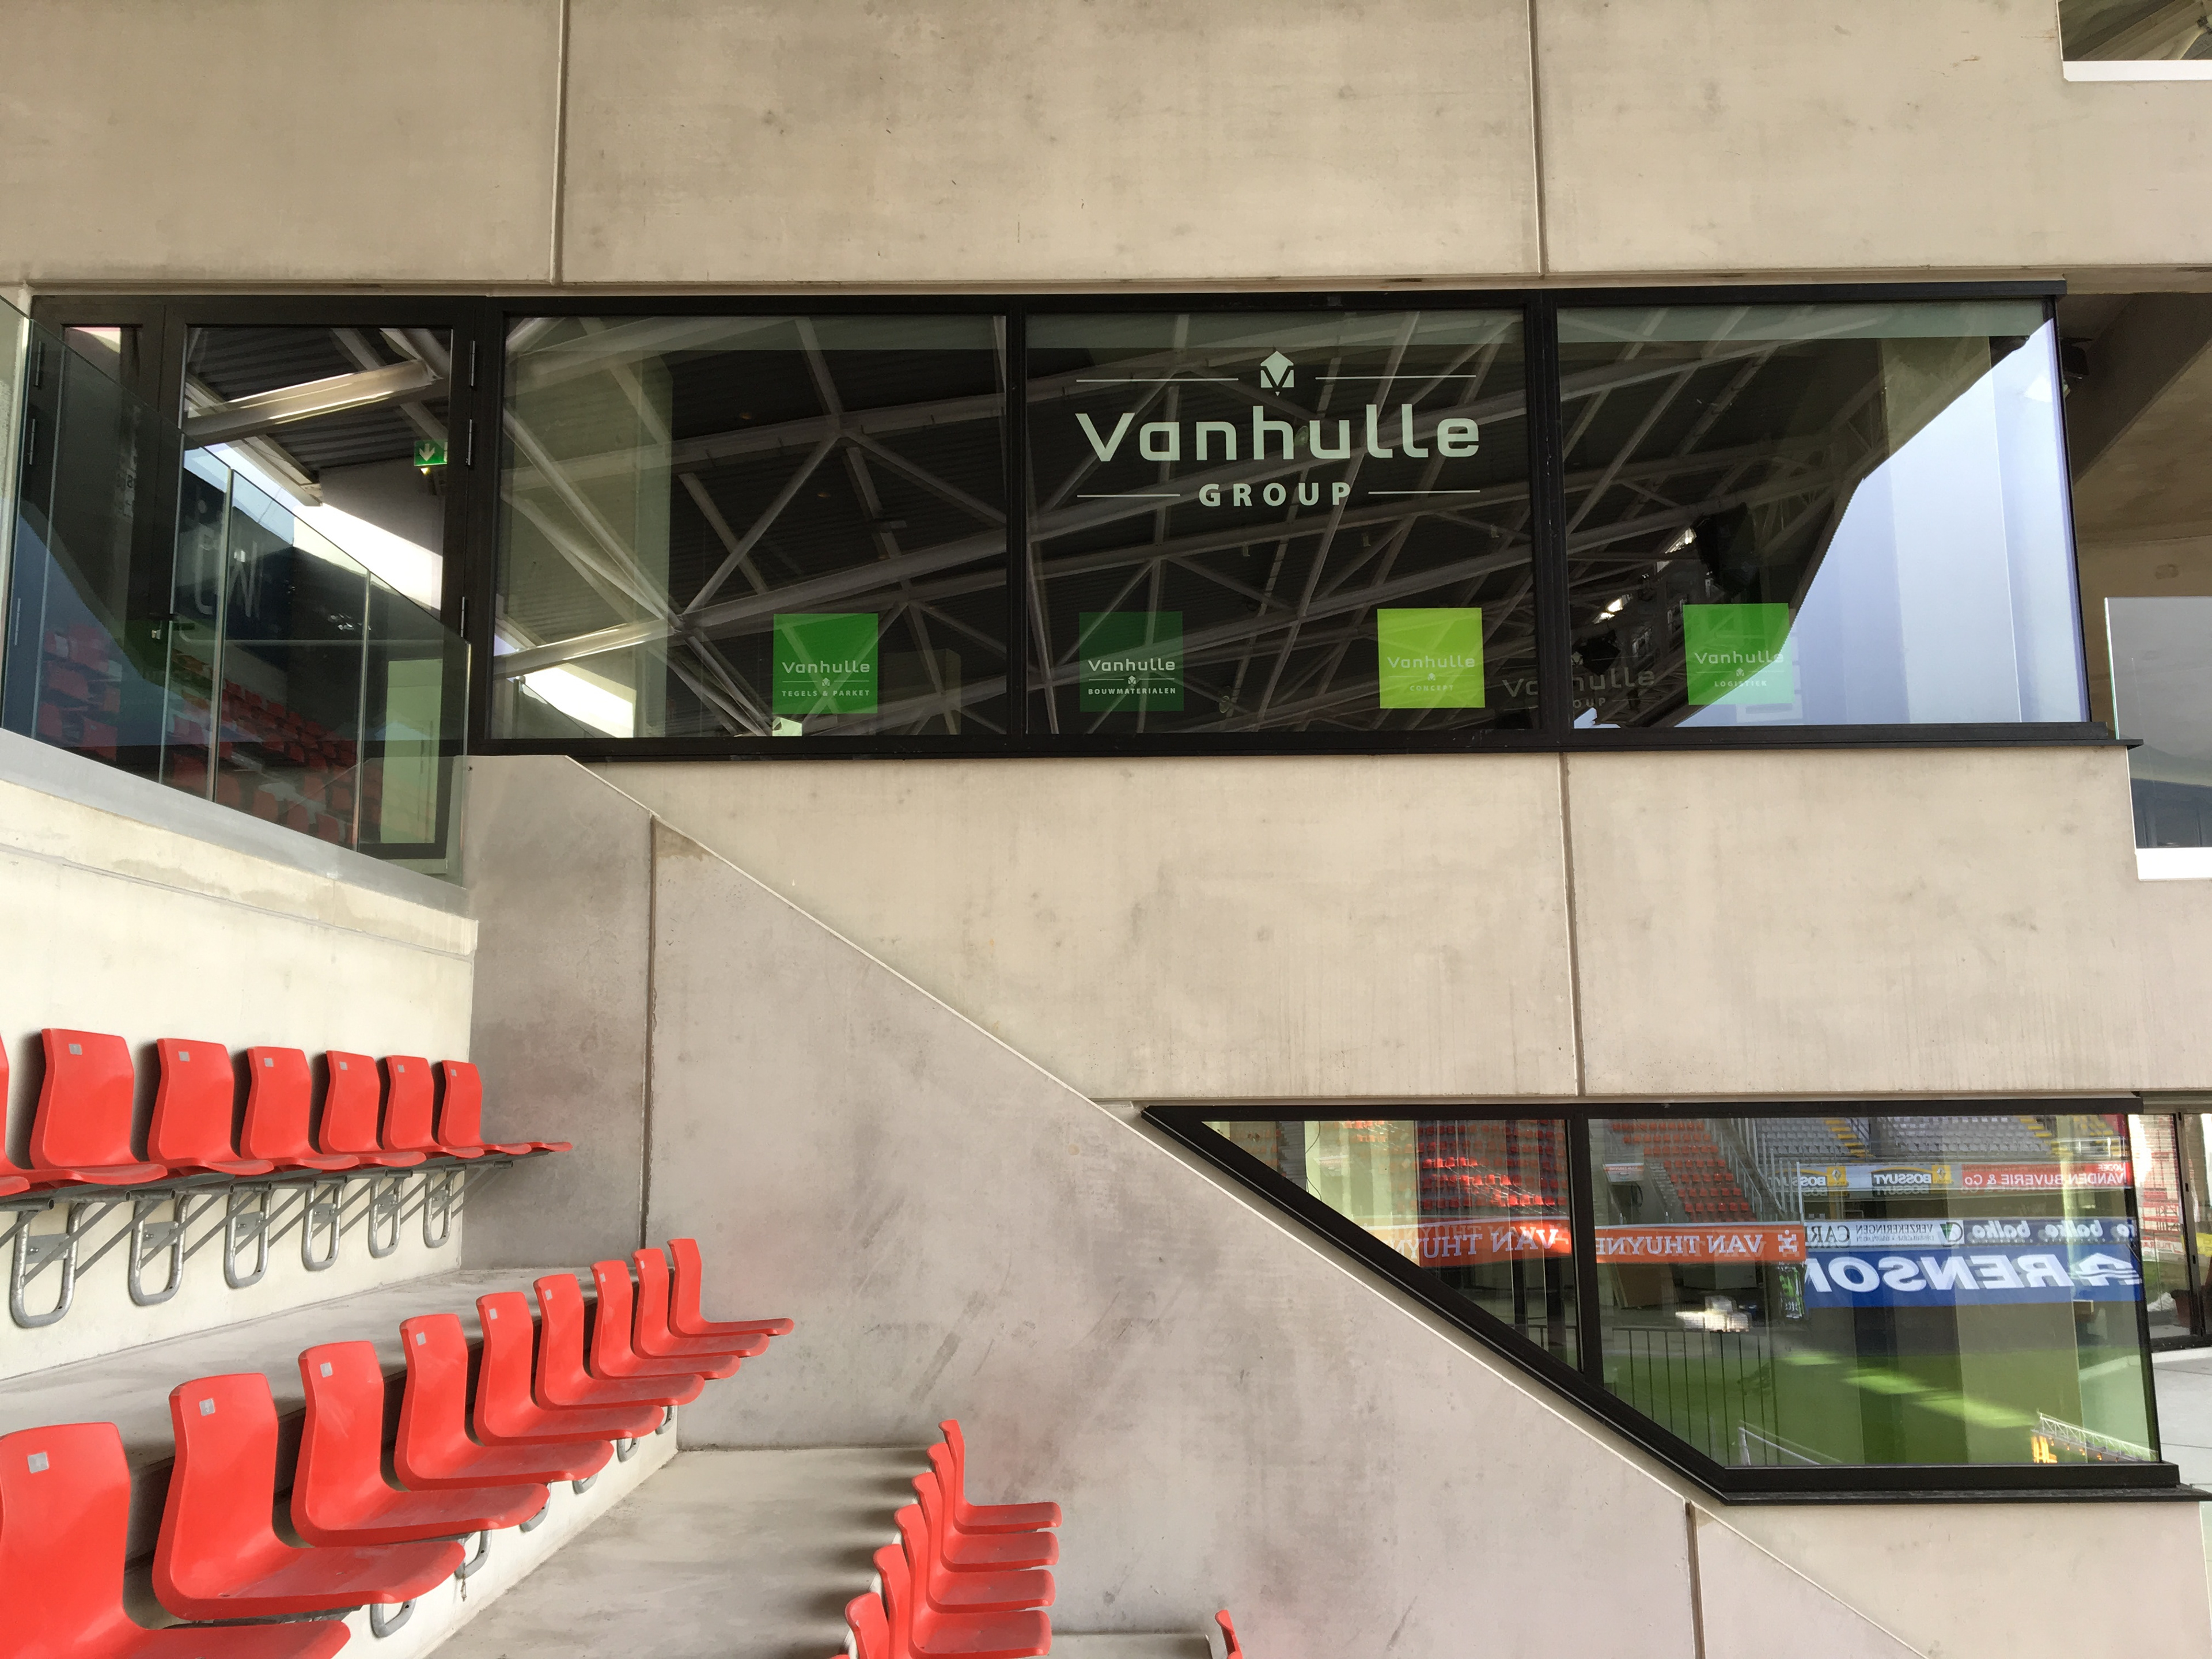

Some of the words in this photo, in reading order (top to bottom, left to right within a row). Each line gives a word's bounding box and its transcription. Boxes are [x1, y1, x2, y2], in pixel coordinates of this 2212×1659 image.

[1075, 404, 1479, 461] Vanhulle
[1199, 482, 1351, 506] GROUP
[1387, 655, 1475, 668] Vanhulle
[1694, 650, 1784, 664] Vanhulle
[782, 660, 870, 673] Vanhulle
[1088, 658, 1175, 672] Vanhulle
